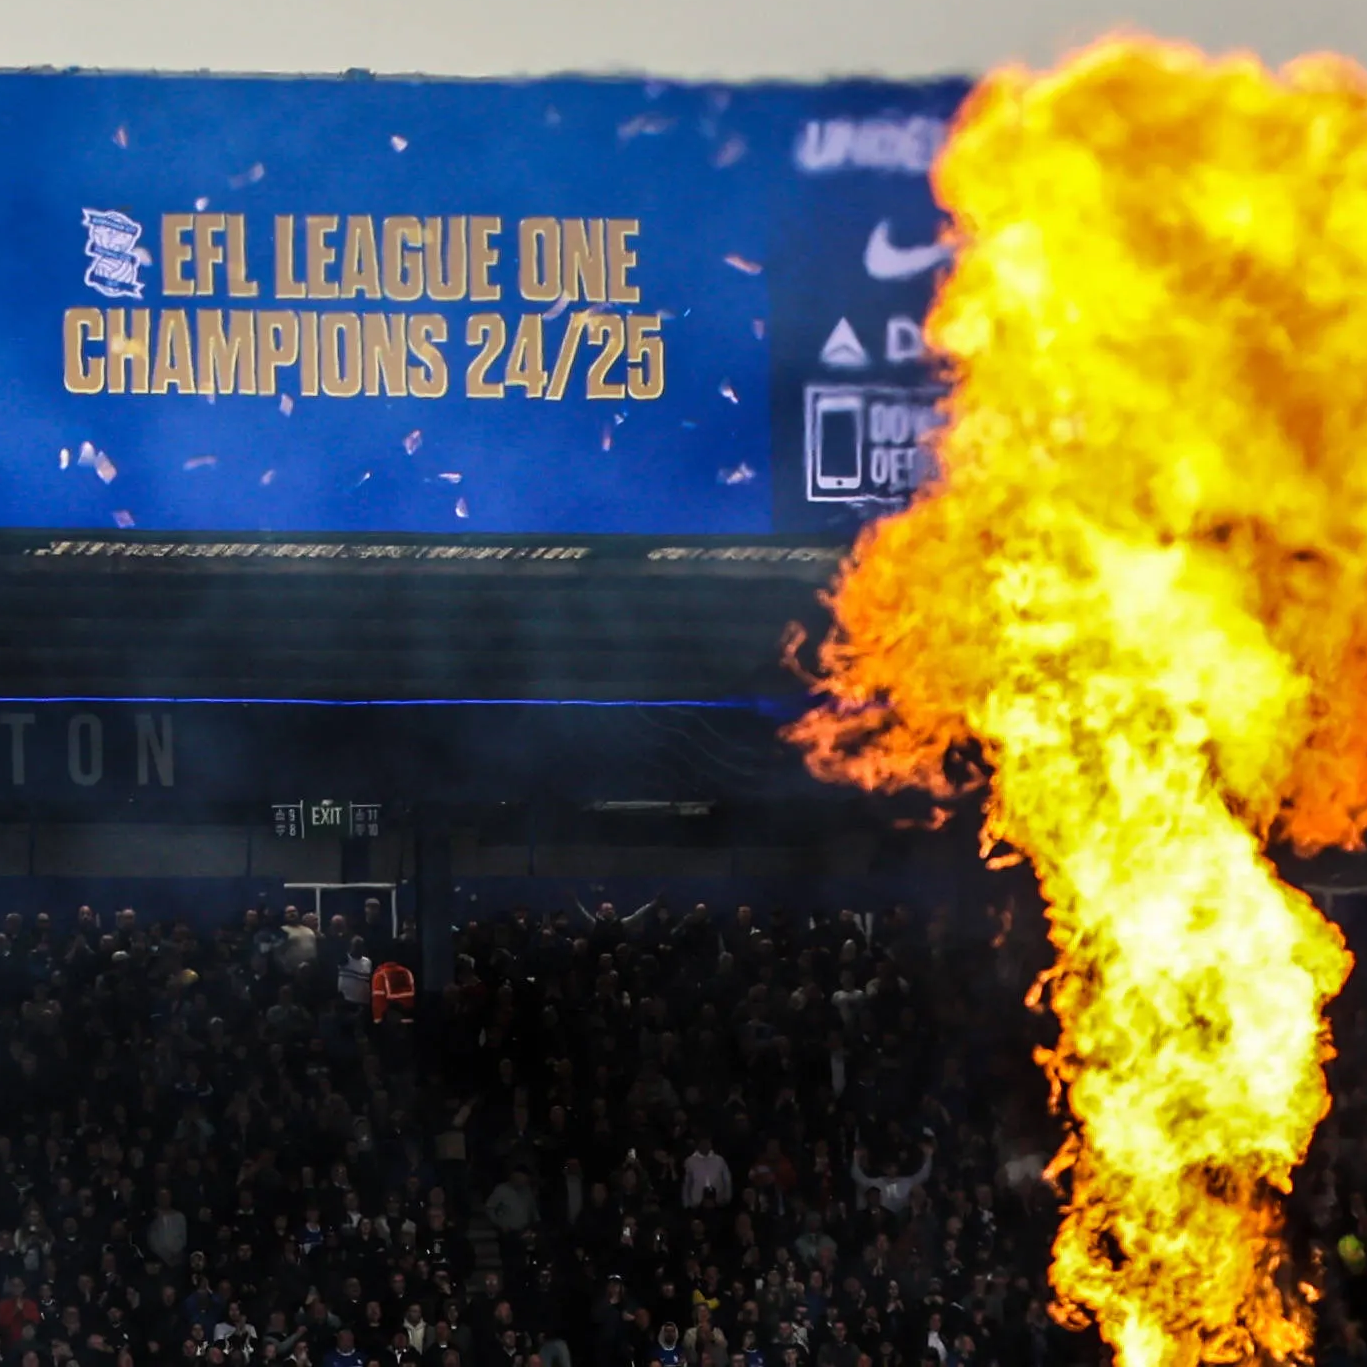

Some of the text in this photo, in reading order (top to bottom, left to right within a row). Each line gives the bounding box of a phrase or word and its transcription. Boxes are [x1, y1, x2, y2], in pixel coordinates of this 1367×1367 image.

[161, 212, 640, 303] EFL LEAGUE ONE
[63, 308, 665, 400] CHAMPIONS 24/25
[312, 807, 342, 825] EXIT
